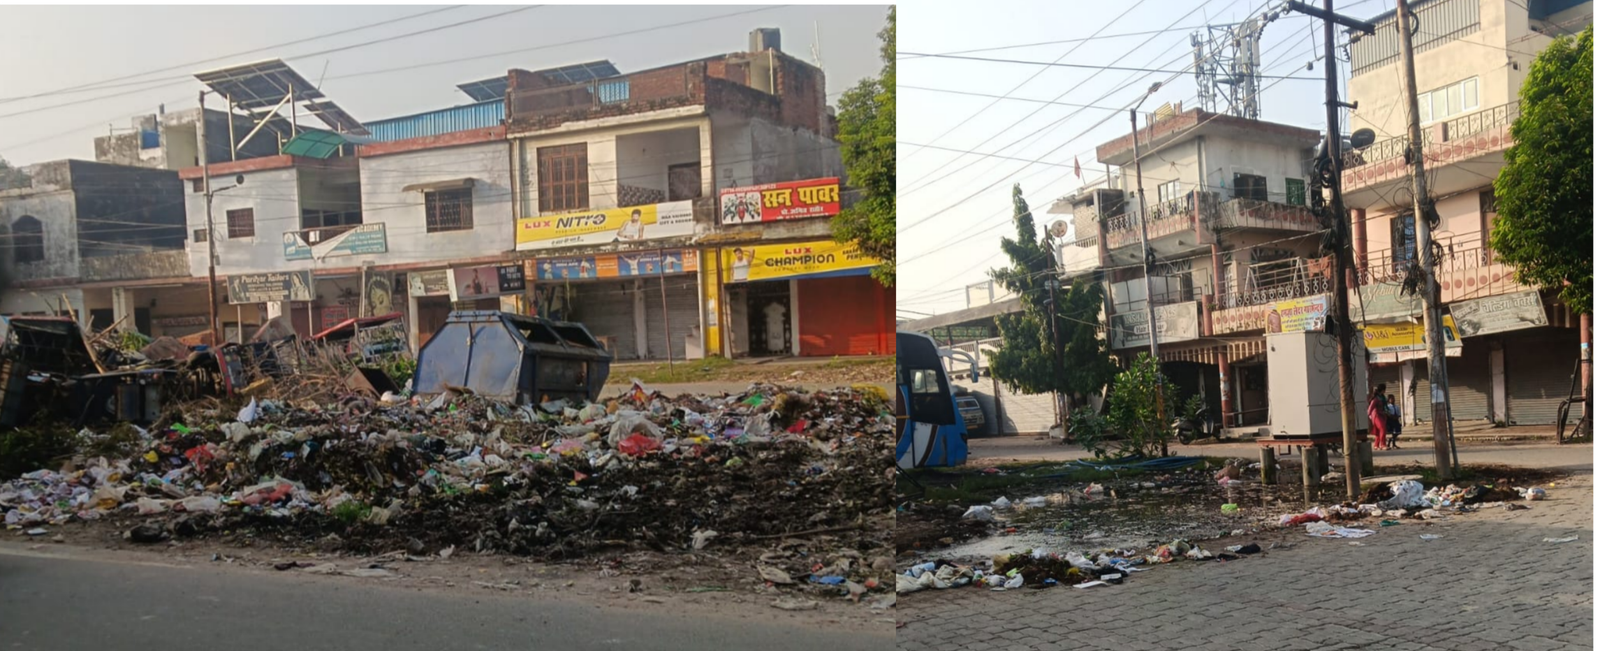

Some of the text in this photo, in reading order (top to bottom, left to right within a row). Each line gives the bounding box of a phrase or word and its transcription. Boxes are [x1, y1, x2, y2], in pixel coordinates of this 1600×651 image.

[762, 188, 793, 208] सन
[797, 184, 839, 205] पावर
[525, 213, 606, 229] LUX NITRO
[784, 247, 812, 255] LUX
[765, 253, 835, 267] CHAMPION
[267, 273, 289, 281] Tailors
